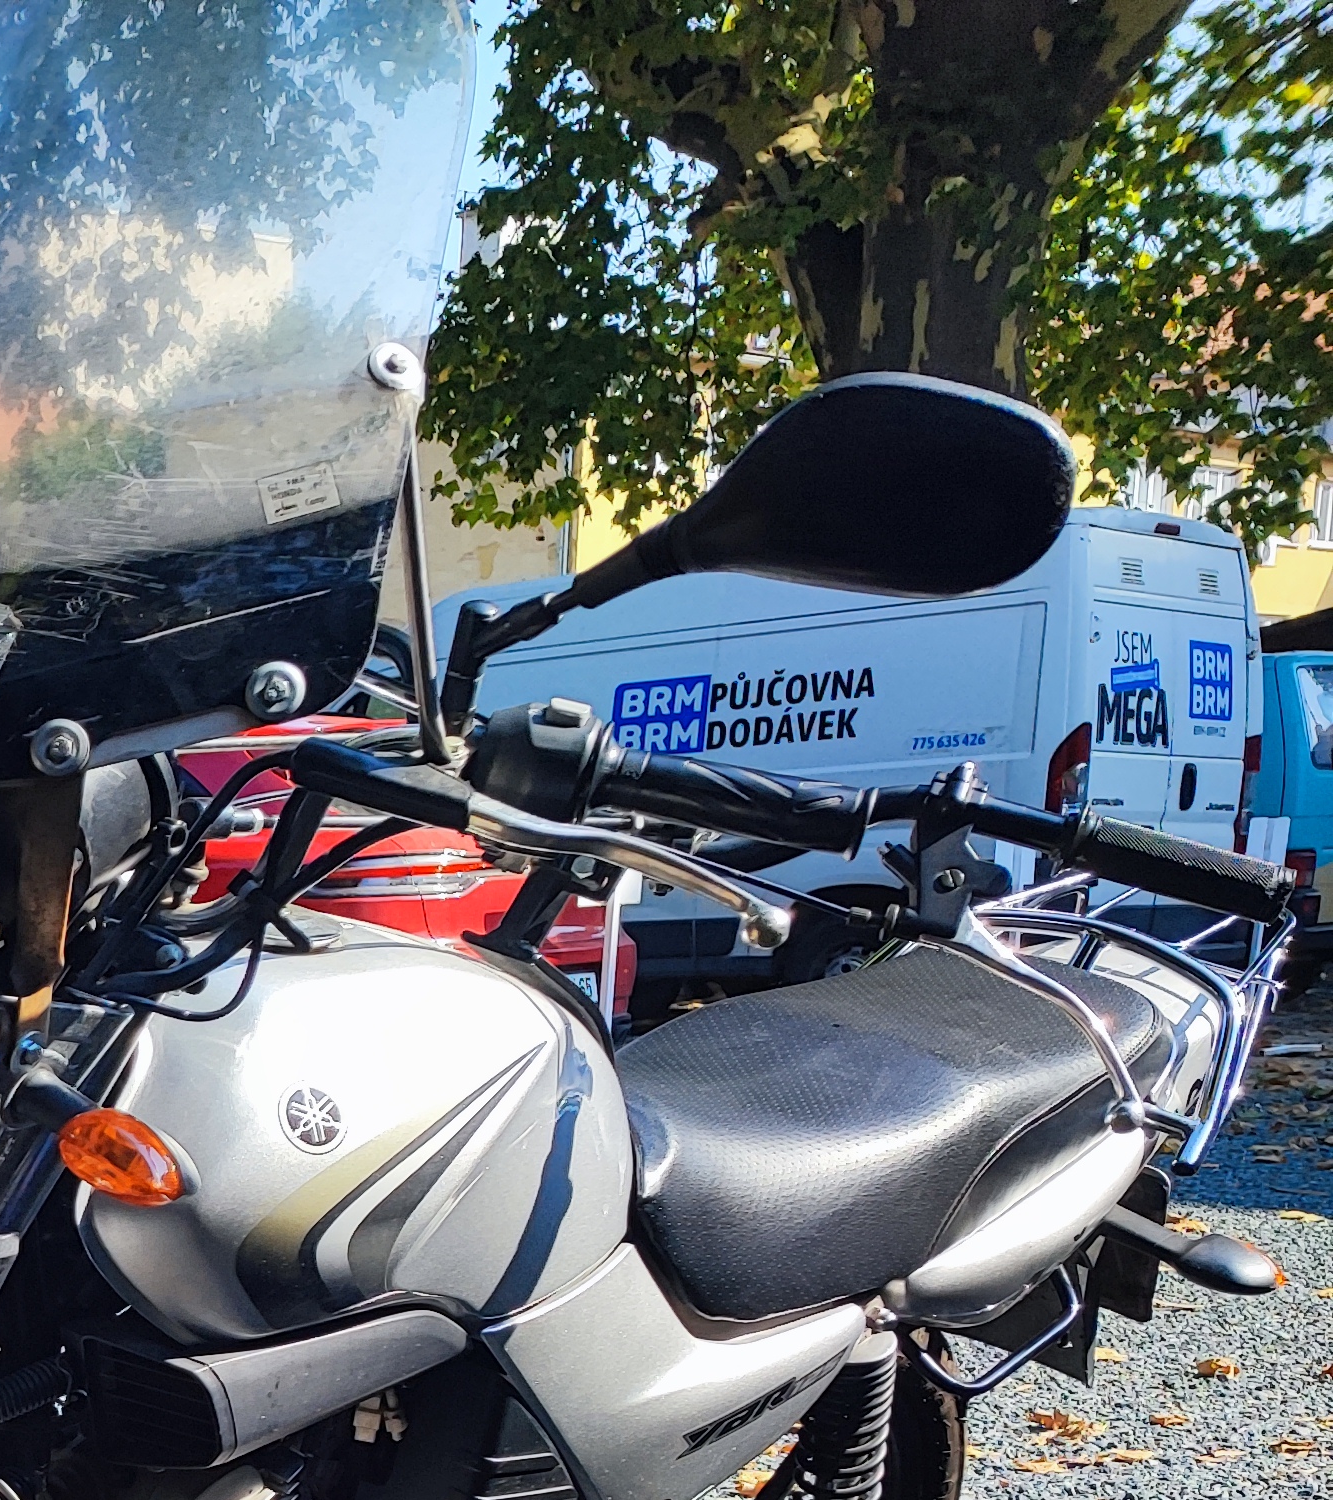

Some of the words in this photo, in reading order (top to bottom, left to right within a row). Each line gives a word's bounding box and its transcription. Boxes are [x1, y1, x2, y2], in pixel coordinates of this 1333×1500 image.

[1114, 629, 1153, 664] JSEM
[1193, 648, 1230, 682] BRM
[621, 681, 705, 719] BRM
[709, 666, 876, 713] PŮJČOVNA
[1193, 684, 1230, 717] BRM
[706, 707, 859, 750] DODÁVEK
[1096, 683, 1169, 749] MEGA
[618, 718, 702, 751] BRM
[912, 736, 935, 750] 775
[937, 734, 960, 748] 635
[961, 733, 986, 747] 426
